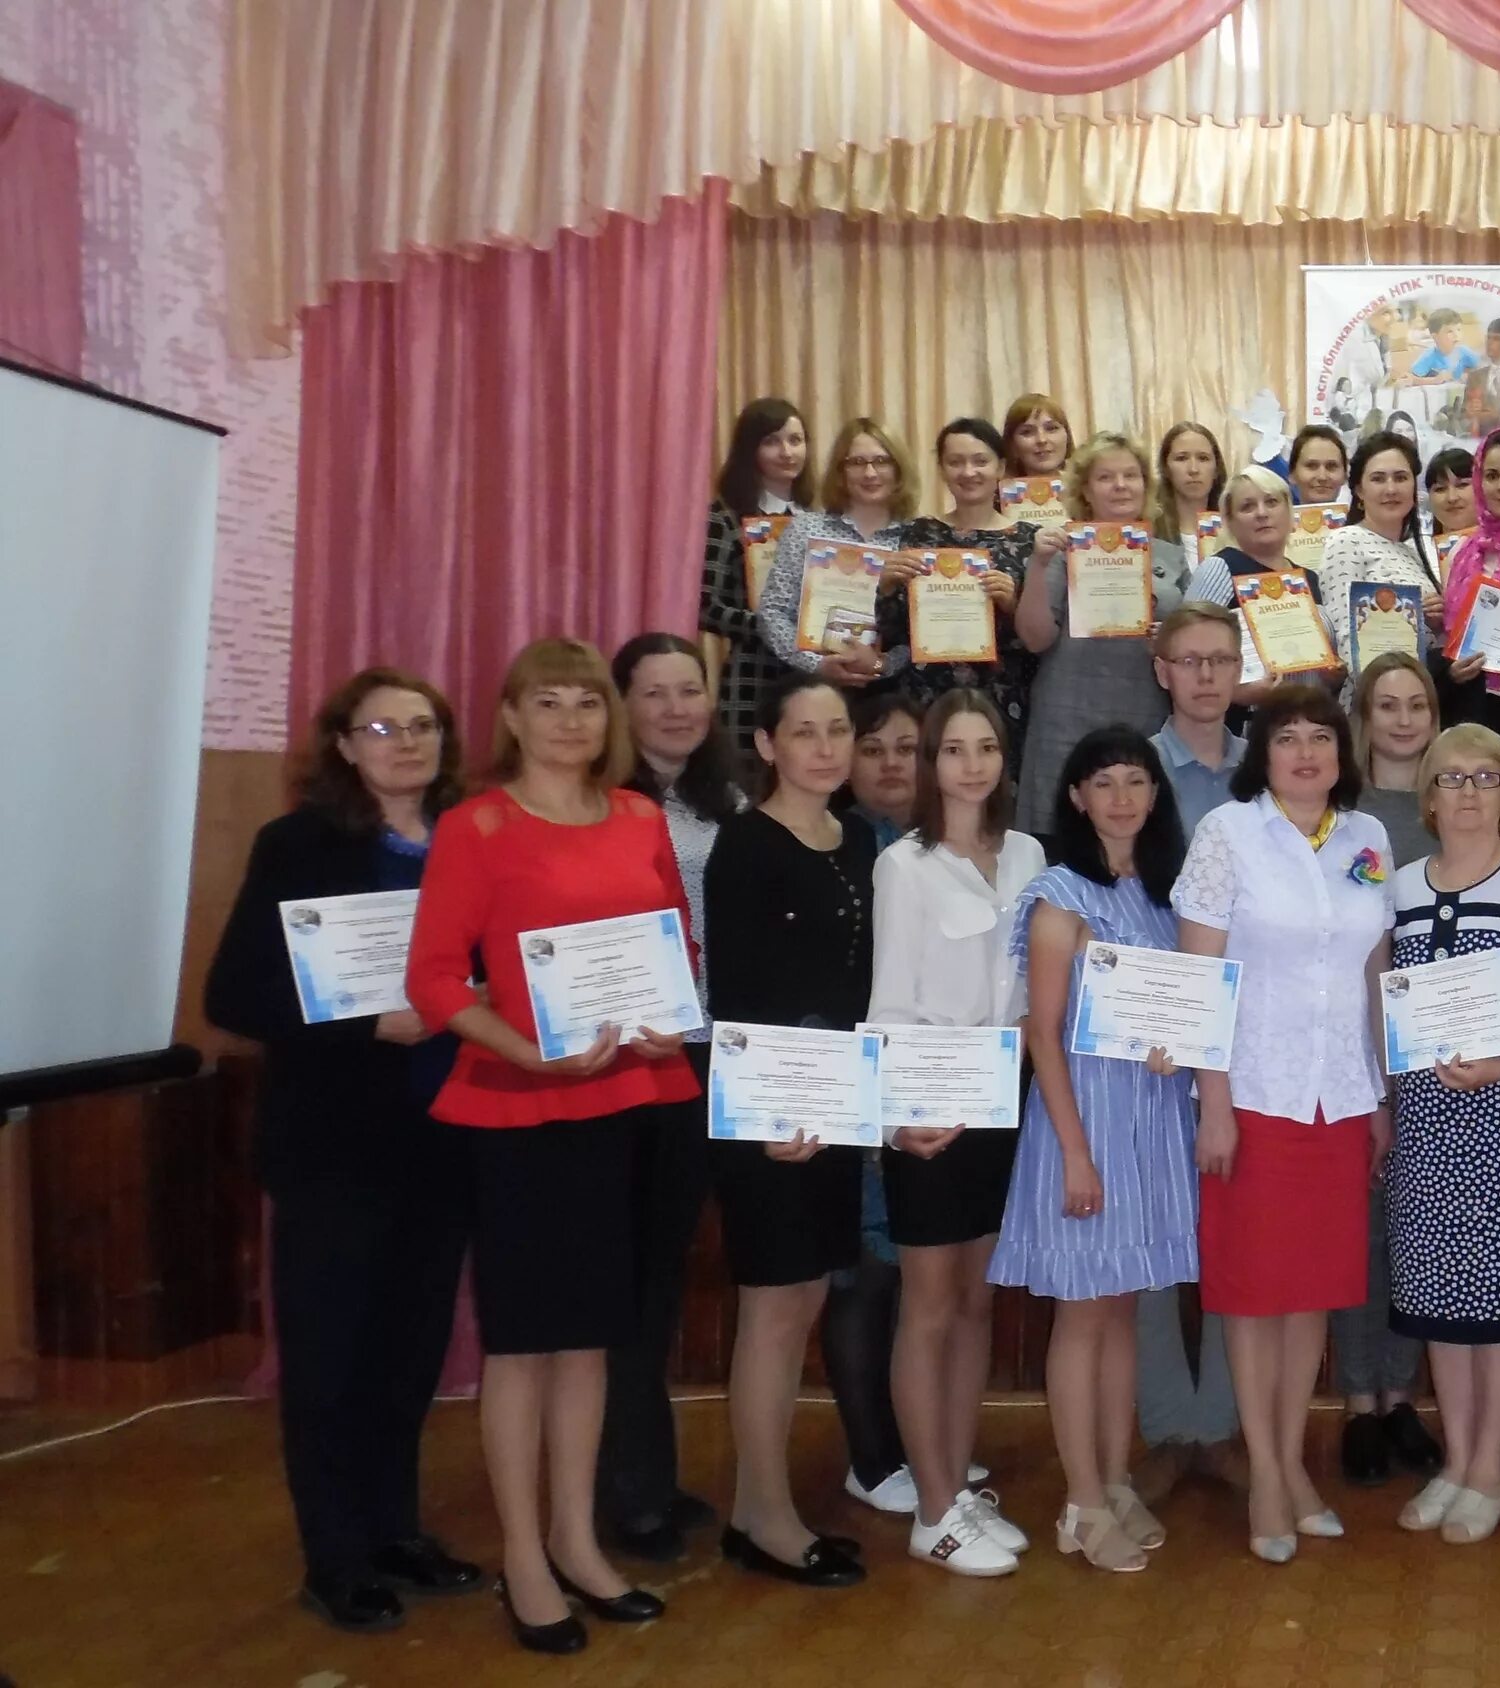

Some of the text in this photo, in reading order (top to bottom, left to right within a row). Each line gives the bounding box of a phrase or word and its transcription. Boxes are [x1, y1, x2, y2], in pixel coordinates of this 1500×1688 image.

[1389, 277, 1424, 298] НПК
[1018, 509, 1065, 519] ДИПЛОМ
[1084, 557, 1134, 567] ДИПЛОМ
[926, 583, 976, 593] ДИПЛОМ
[1258, 601, 1301, 615] ДИПЛОМ
